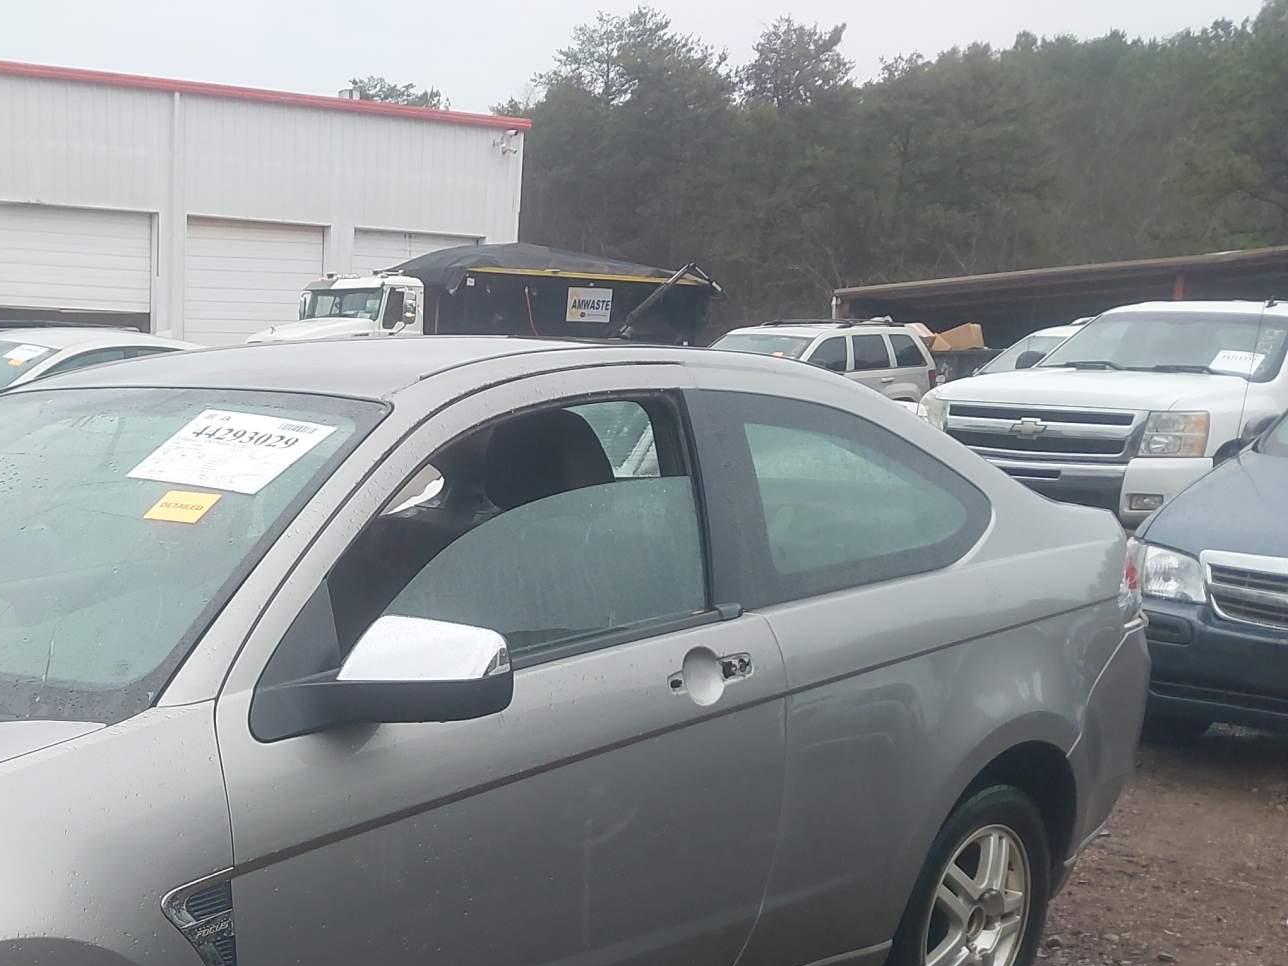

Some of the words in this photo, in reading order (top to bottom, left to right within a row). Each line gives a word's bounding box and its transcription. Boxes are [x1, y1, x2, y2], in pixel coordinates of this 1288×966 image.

[570, 298, 612, 311] AMWASTE
[191, 424, 300, 449] 44293029
[159, 501, 205, 512] DETAILED
[195, 919, 230, 938] FOCUS
